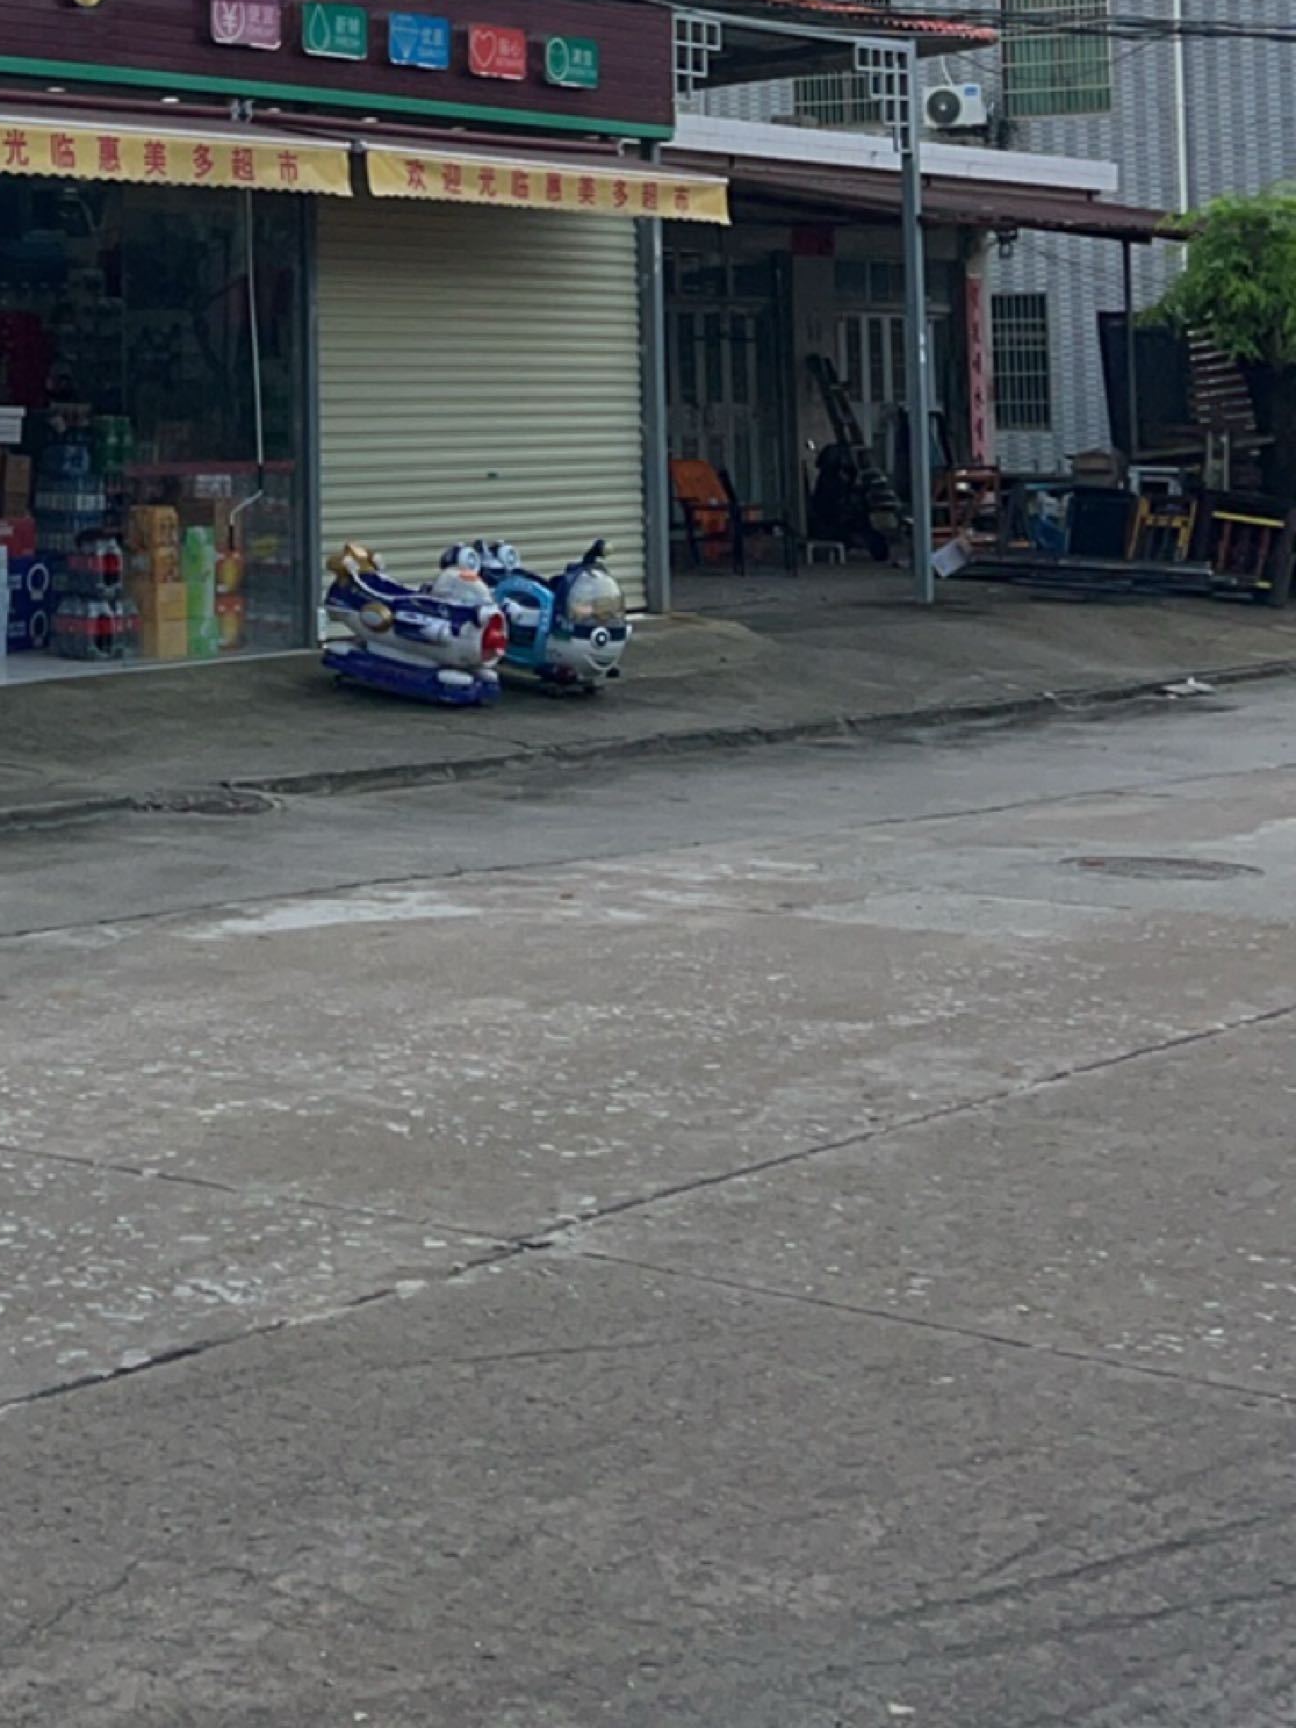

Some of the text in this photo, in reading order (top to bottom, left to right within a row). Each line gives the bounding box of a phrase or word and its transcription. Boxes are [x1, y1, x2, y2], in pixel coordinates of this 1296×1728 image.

[405, 158, 693, 213] 欢迎光临惠美多超市
